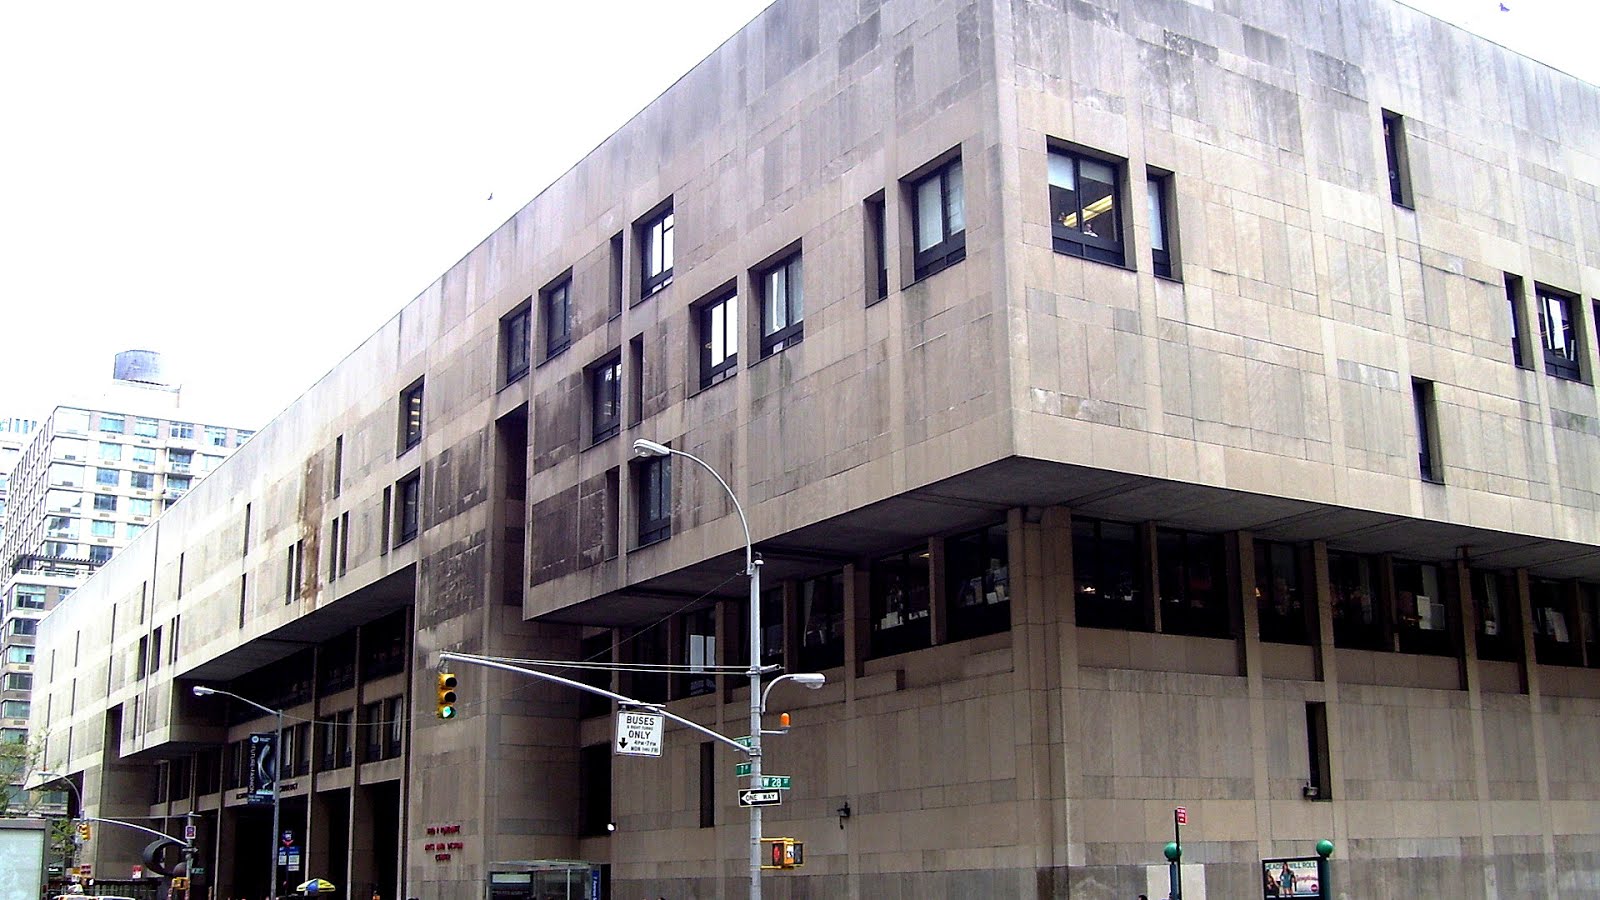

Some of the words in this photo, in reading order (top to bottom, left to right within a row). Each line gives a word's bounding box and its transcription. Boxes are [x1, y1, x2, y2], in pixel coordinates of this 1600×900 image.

[627, 716, 654, 725] BUSES
[628, 730, 650, 739] ONLY
[762, 778, 769, 787] W
[771, 778, 782, 787] 28
